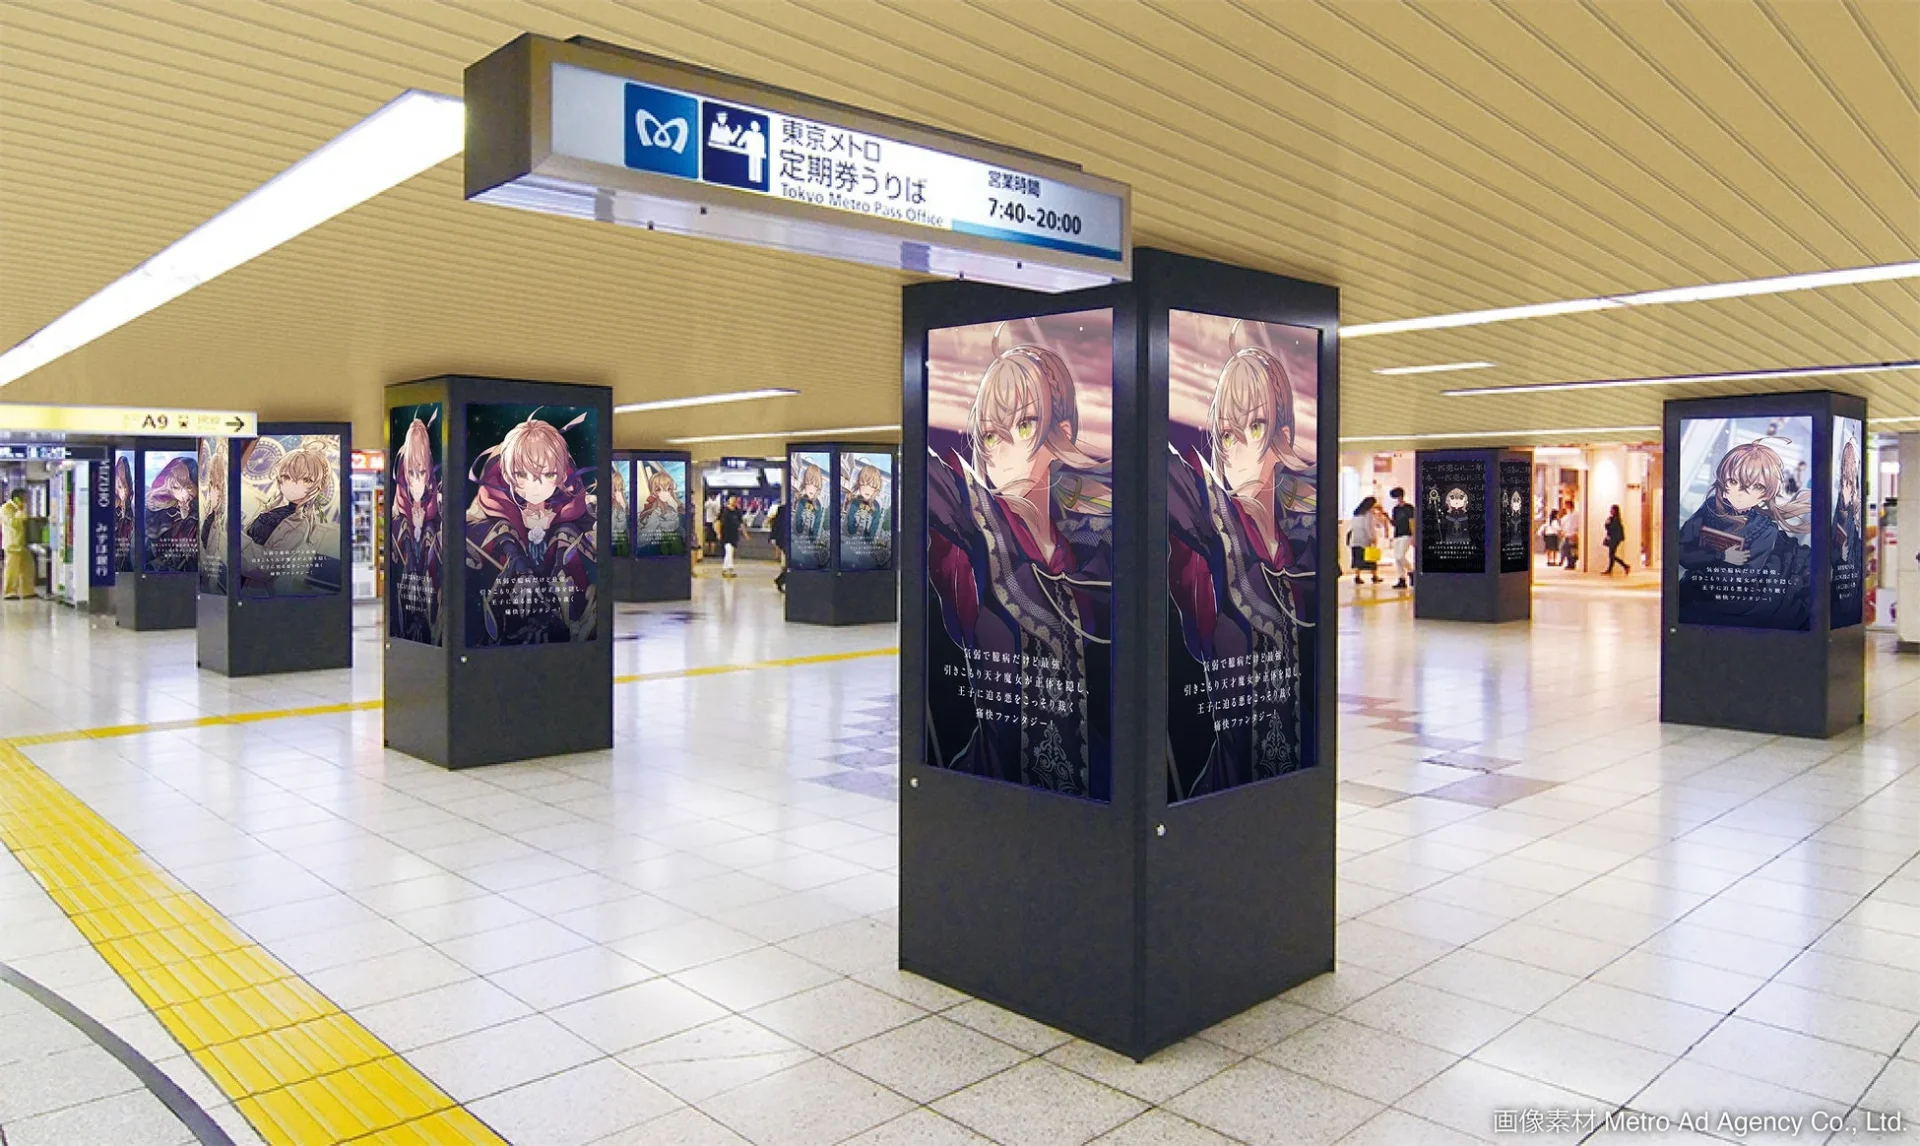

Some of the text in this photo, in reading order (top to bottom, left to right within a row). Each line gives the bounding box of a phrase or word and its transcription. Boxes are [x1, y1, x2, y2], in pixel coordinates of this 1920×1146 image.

[782, 118, 880, 162] 東京メトロ
[780, 149, 928, 204] 定期券うりば
[988, 170, 1040, 198] 営業時間
[781, 182, 944, 227] Tokyo Metro Pass Office
[142, 414, 168, 429] A9
